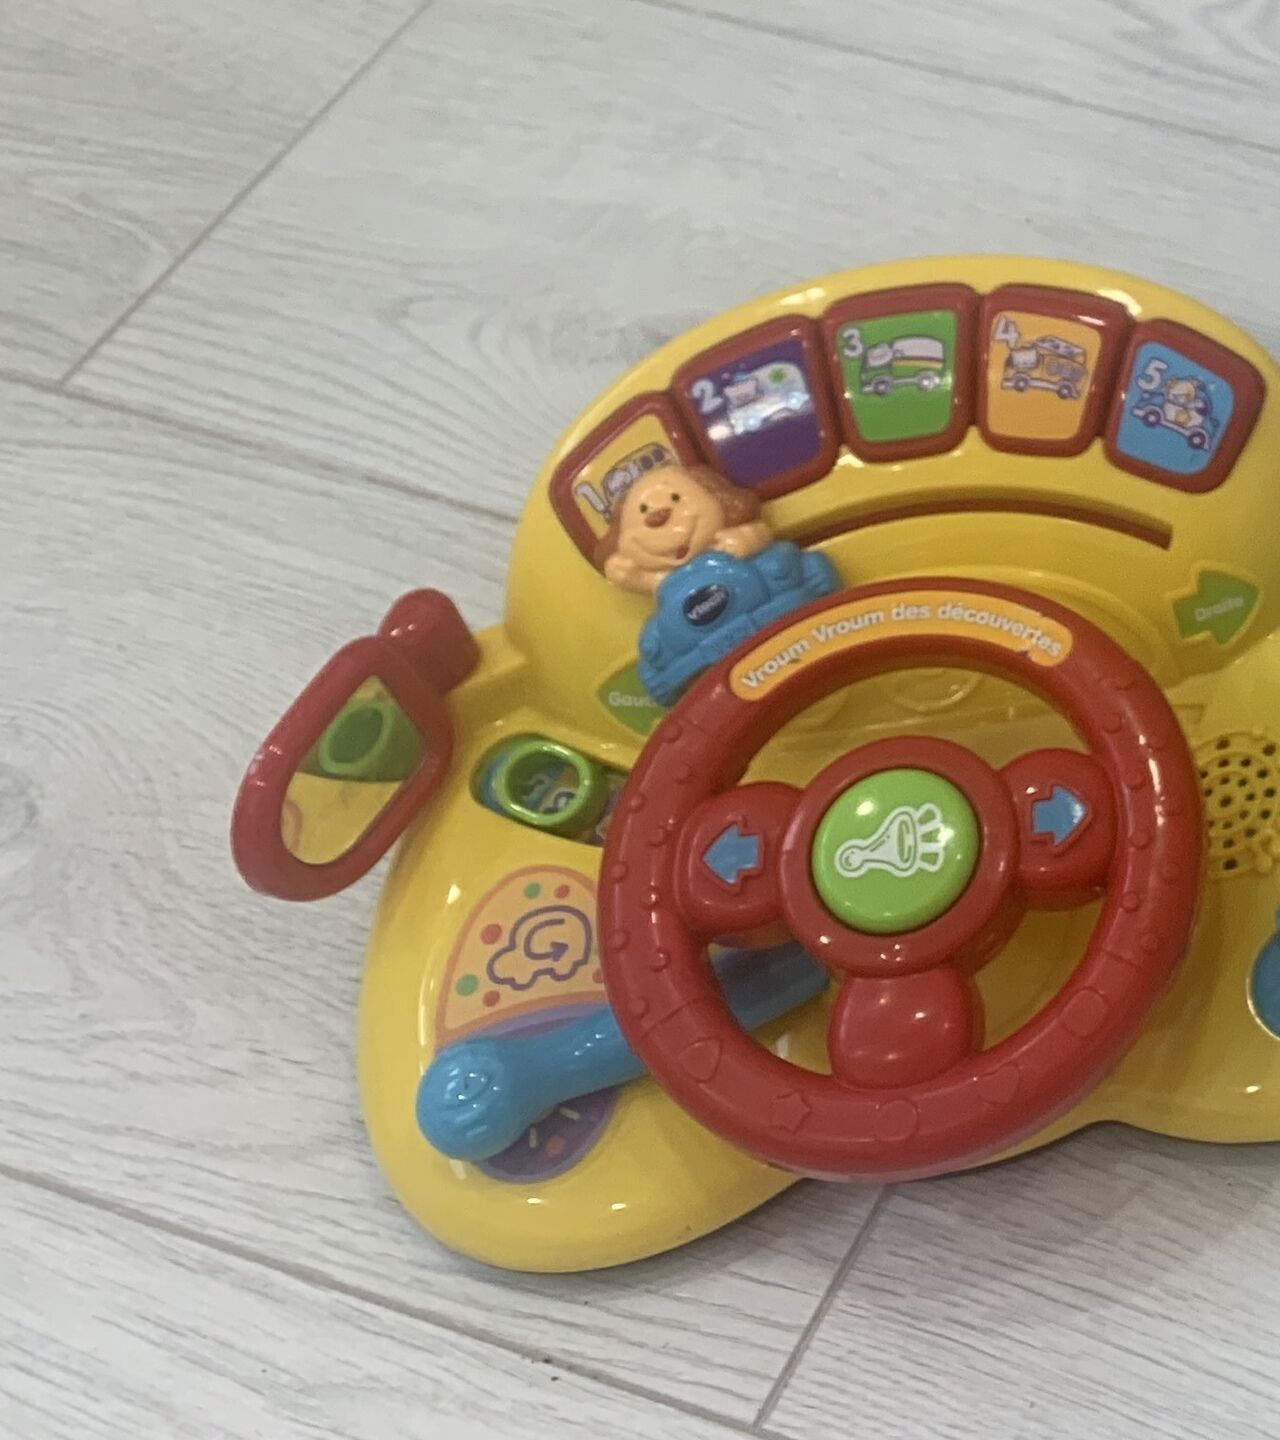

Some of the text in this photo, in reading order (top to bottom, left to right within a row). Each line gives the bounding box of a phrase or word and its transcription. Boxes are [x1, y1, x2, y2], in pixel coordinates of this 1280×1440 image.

[840, 326, 864, 359] 3
[1136, 358, 1163, 393] 5
[690, 378, 723, 415] 2
[1194, 595, 1245, 624] Droite
[740, 601, 1063, 689] Vroum Vroum des découvertes
